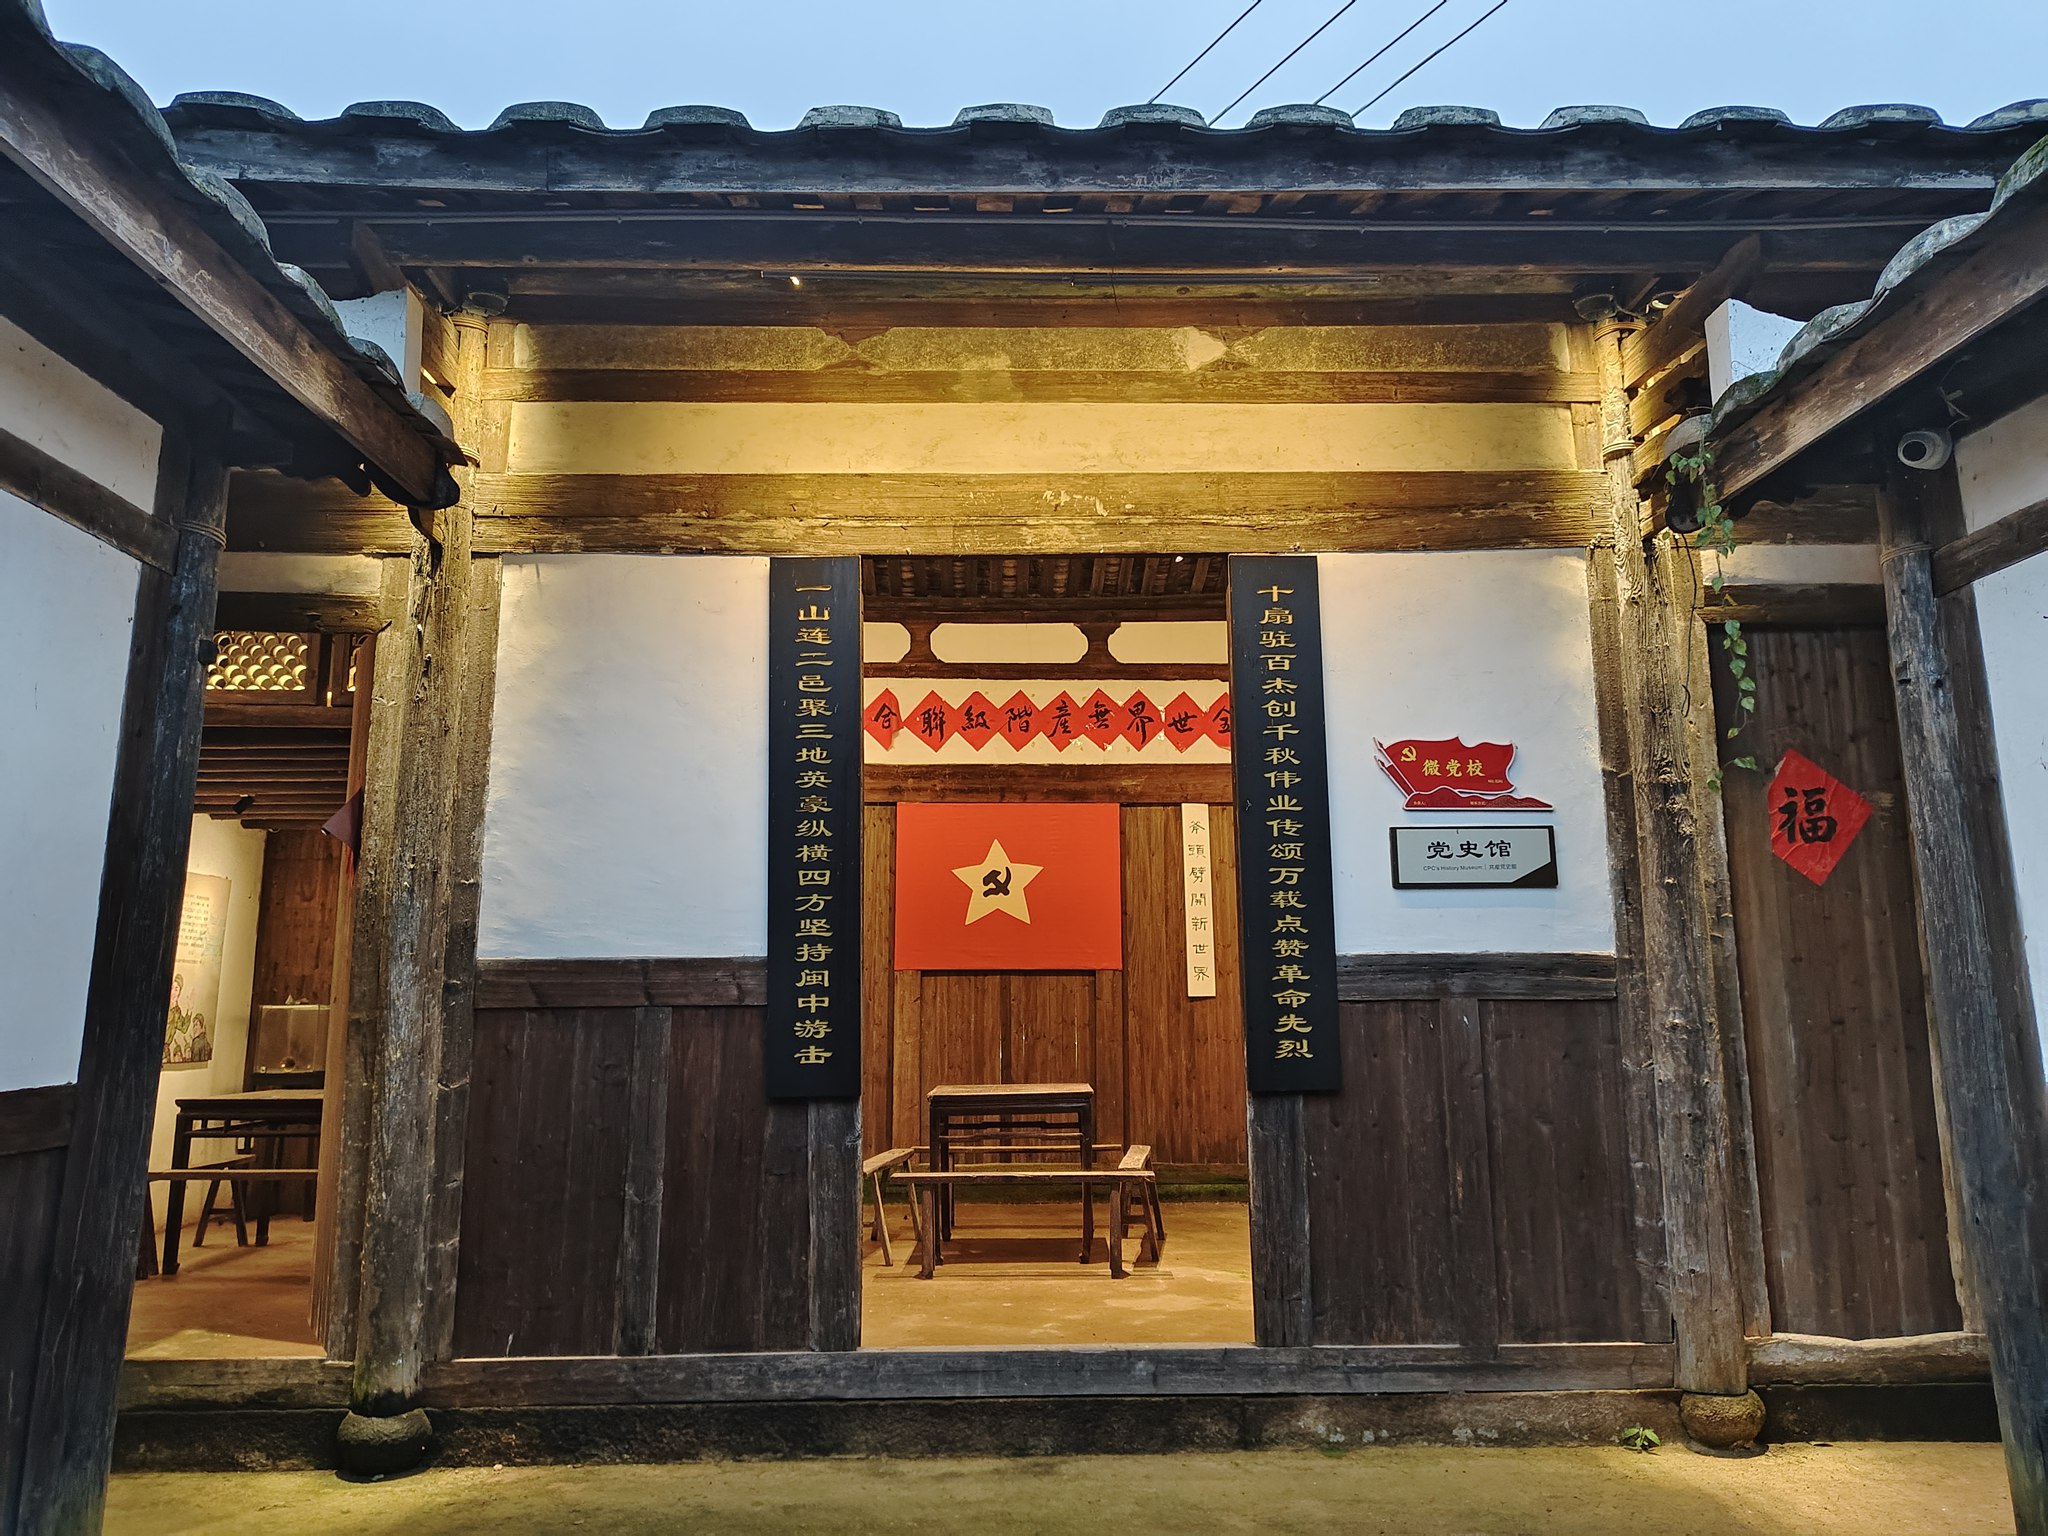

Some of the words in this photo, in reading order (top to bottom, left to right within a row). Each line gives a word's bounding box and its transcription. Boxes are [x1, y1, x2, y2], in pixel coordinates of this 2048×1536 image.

[1421, 759, 1486, 778] 微党校
[794, 584, 834, 1064] 一山连二邑聚三地英豪纵横四方坚持闽中游击
[1256, 585, 1314, 1060] 十扇驻百杰创千秋伟业传颂万载点赞革命先烈
[1778, 786, 1838, 844] 福
[1426, 840, 1512, 859] 党史馆
[1441, 864, 1459, 872] History
[1188, 820, 1209, 982] 斧頭劈開新世界
